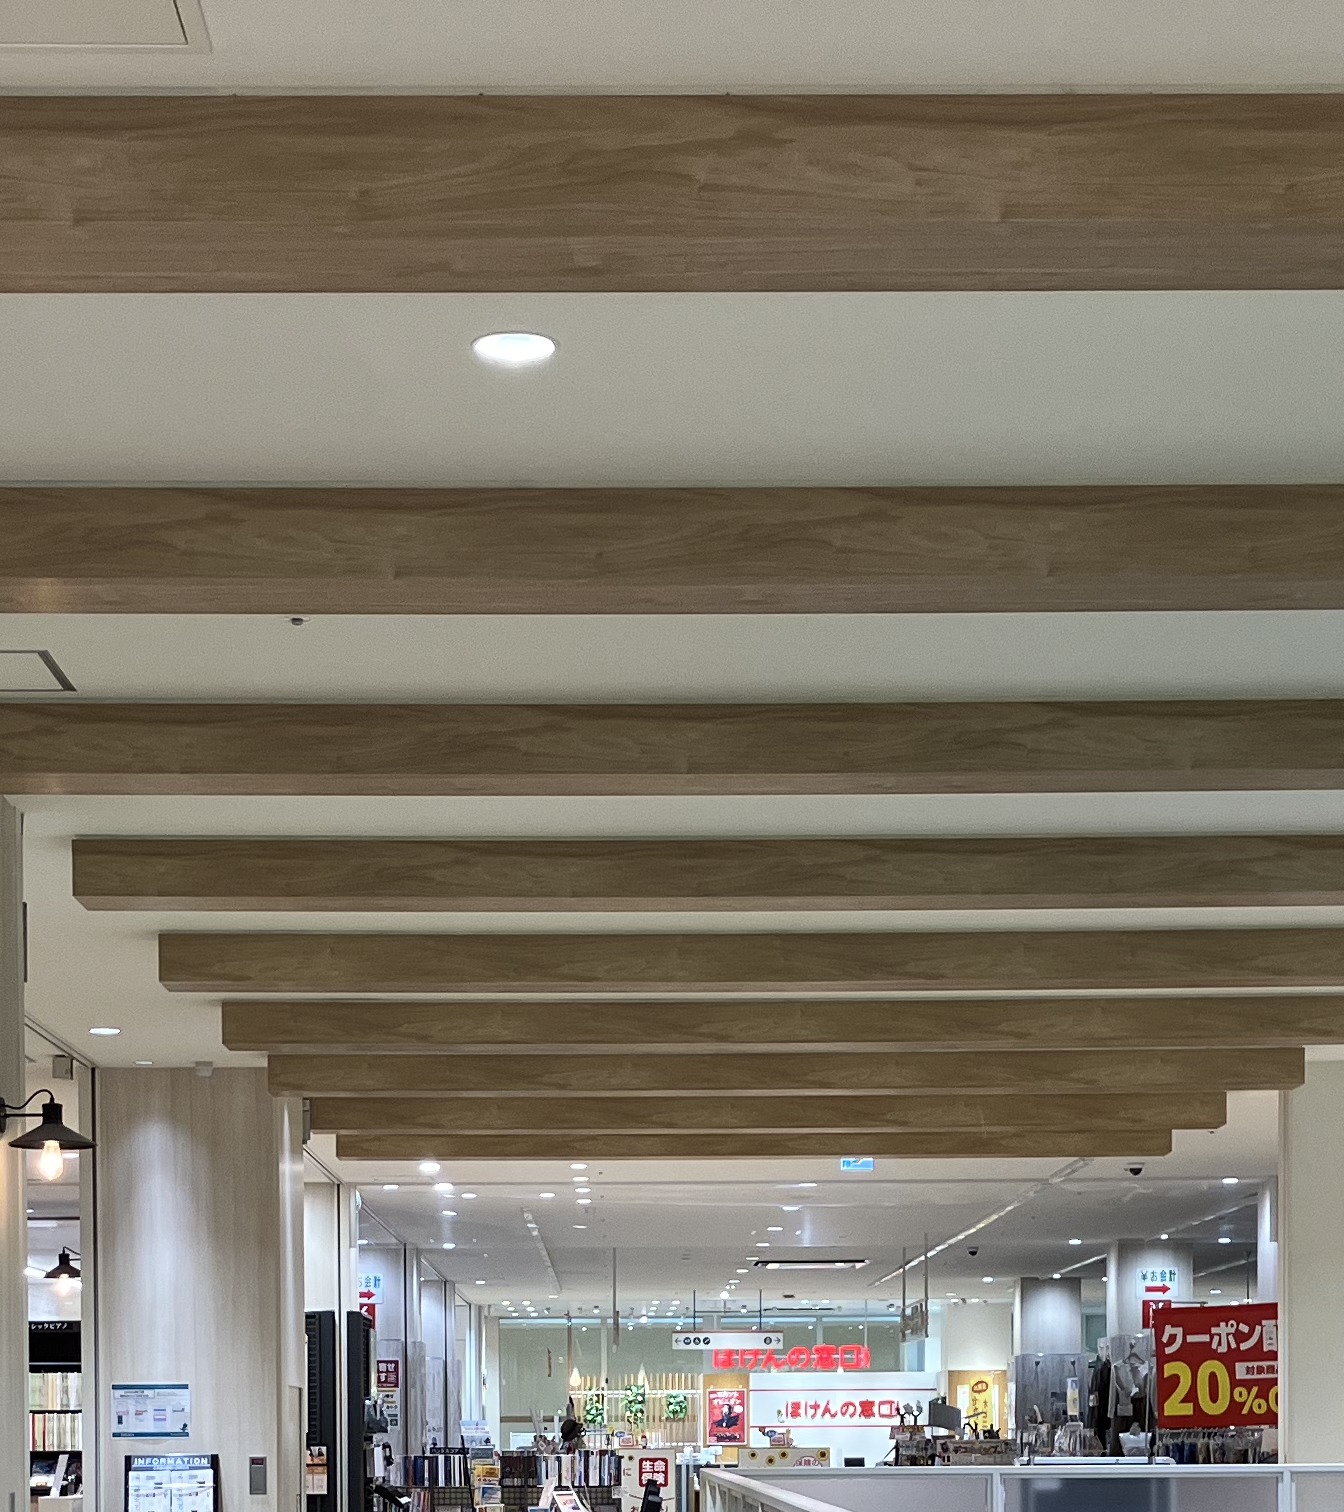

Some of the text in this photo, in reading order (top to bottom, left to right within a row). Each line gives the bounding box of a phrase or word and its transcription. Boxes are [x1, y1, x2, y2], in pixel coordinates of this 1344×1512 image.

[712, 1344, 864, 1370] ほけんの窓口
[786, 1400, 895, 1419] ほけんの窓口
[134, 1457, 208, 1466] INFORMATION
